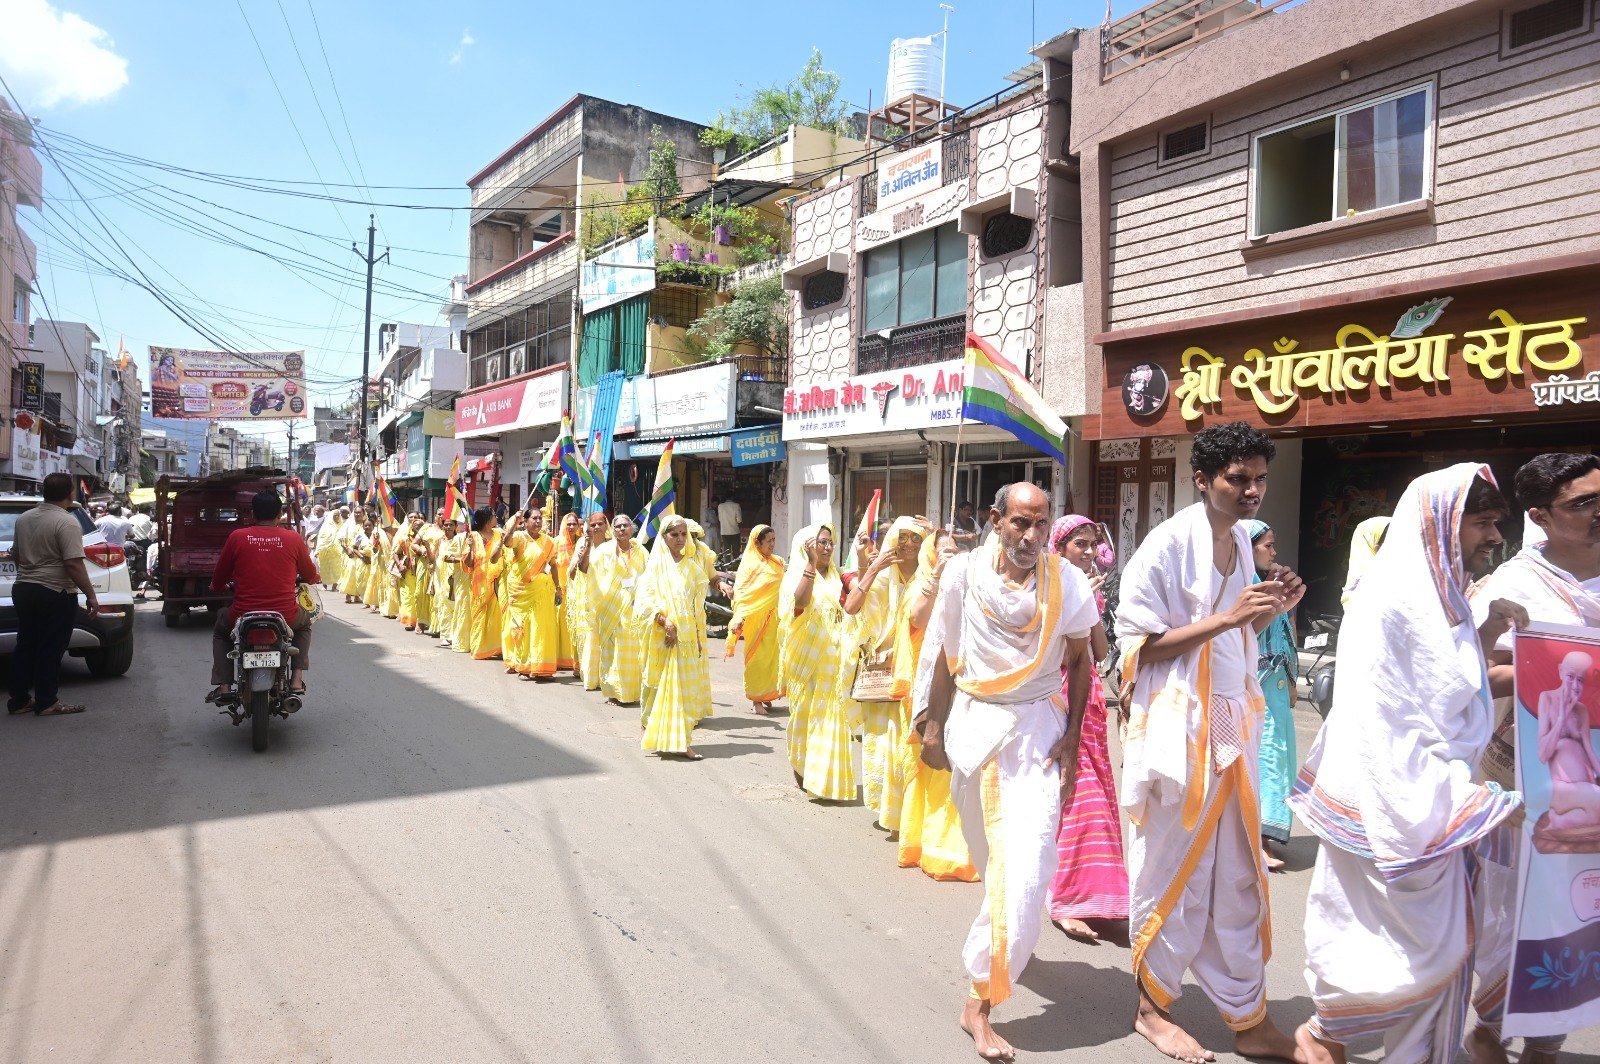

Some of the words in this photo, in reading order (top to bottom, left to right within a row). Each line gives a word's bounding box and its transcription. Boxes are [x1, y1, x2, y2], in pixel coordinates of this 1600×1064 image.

[892, 169, 922, 193] अनिल
[922, 160, 939, 181] जैन
[1174, 346, 1227, 421] श्री
[1462, 309, 1588, 381] सेठ
[799, 385, 836, 412] अनिल
[841, 380, 864, 406] जैन
[903, 374, 925, 398] Dr.
[933, 366, 965, 394] Ani
[485, 401, 497, 413] AXIS
[497, 397, 512, 411] BANK
[680, 438, 719, 452] MEDICINE
[741, 449, 769, 462] मिलती
[1123, 465, 1138, 479] शुभ
[1152, 465, 1167, 476] लाभ
